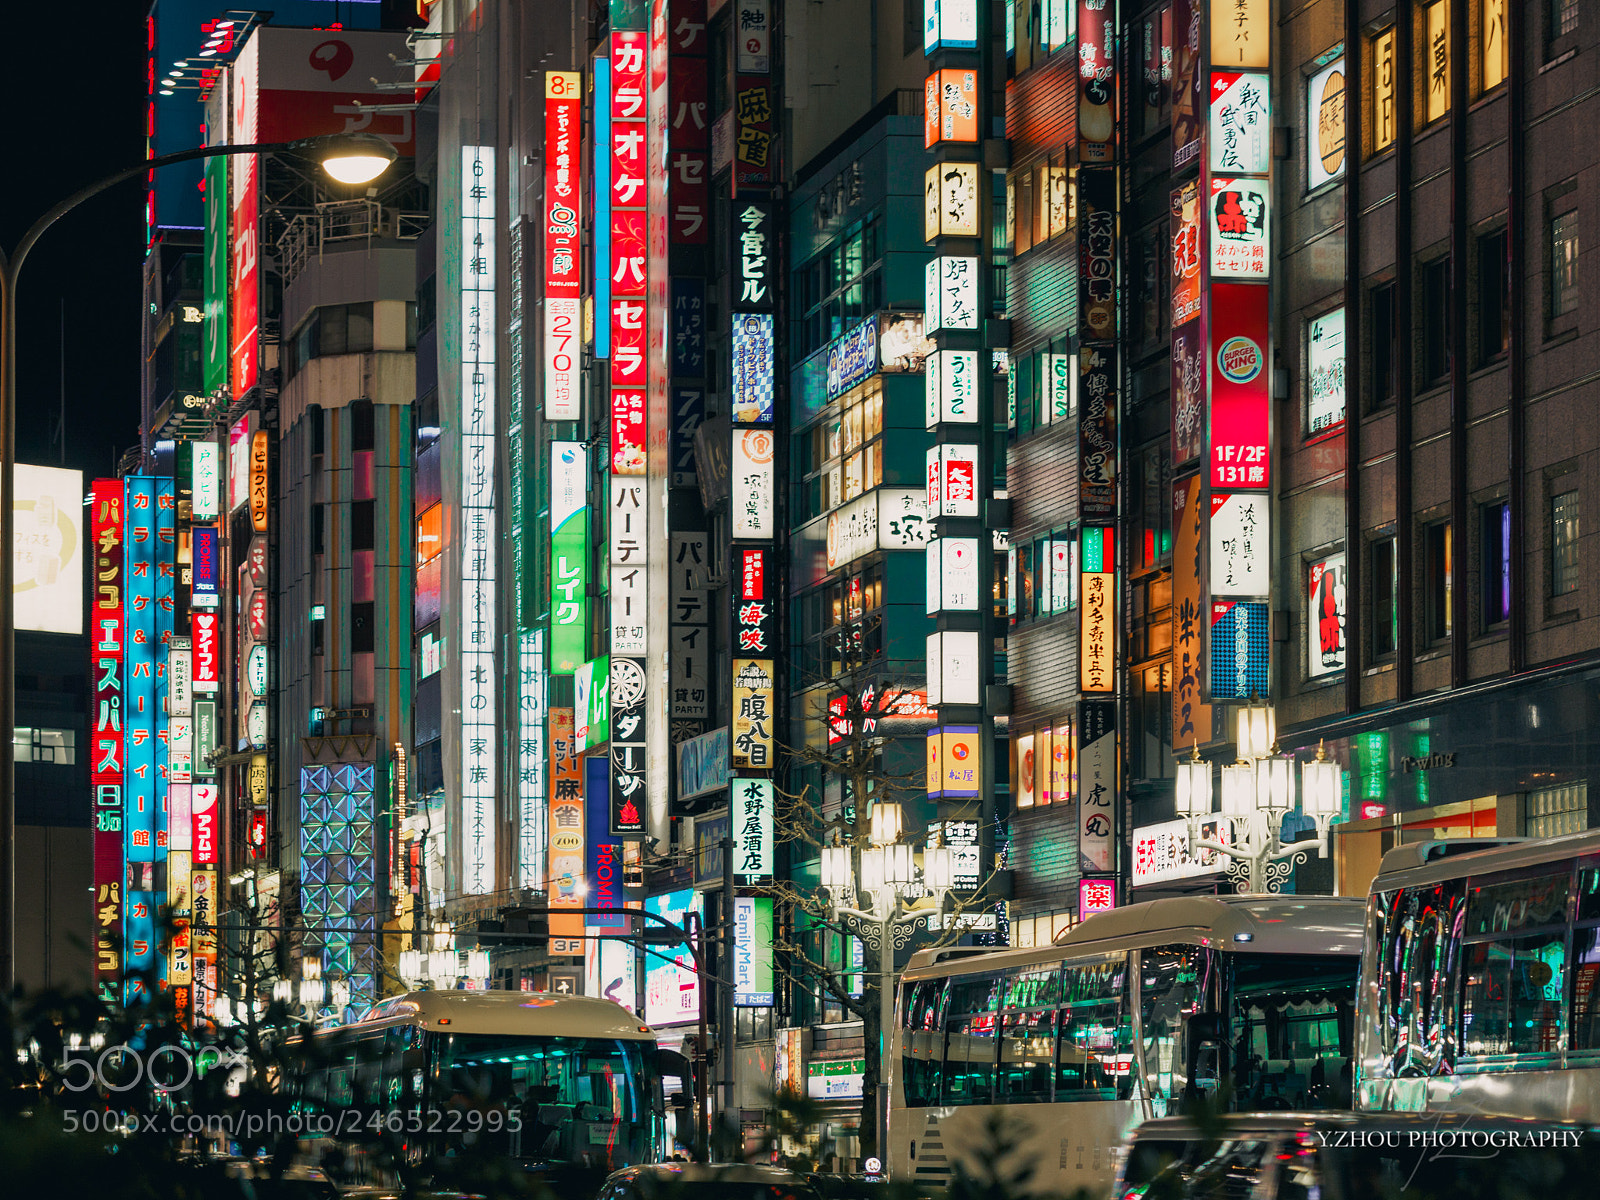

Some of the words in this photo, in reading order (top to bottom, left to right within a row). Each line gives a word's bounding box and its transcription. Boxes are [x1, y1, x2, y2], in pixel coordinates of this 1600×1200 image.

[551, 75, 574, 95] 8F
[615, 43, 645, 204] カラオケ
[738, 87, 771, 169] 麻雀
[1219, 104, 1246, 170] 武勇伝
[672, 101, 706, 237] パセラ
[739, 206, 767, 304] 今宮ビル
[1215, 244, 1264, 259] 赤から鍋
[1215, 259, 1264, 273] セセリ焼
[613, 256, 645, 376] パセラ
[691, 296, 701, 366] カラオケ
[747, 337, 757, 403] ドイツビアホール
[1089, 351, 1107, 368] 4F
[1223, 345, 1255, 362] BURGER
[1225, 352, 1257, 372] KING
[629, 394, 642, 425] 名物
[677, 391, 701, 468] 747
[1216, 446, 1265, 463] 1F/2F
[1217, 466, 1265, 482] 131席
[199, 449, 213, 508] 戸谷ビル
[948, 467, 973, 501] 大陸
[98, 498, 121, 609] パチンコ
[200, 533, 211, 580] PROMISE
[616, 487, 642, 616] パーティー
[1238, 503, 1258, 573] 淡路島と
[557, 556, 580, 624] レイク
[675, 541, 703, 679] パーティー
[952, 594, 964, 605] 3F
[615, 625, 643, 639] 貸切
[615, 642, 643, 650] PARTY
[133, 493, 150, 847] カラオケ&パーティー館
[198, 629, 214, 680] アイフル
[740, 666, 767, 677] 伝説の
[674, 688, 704, 703] 貸切
[674, 706, 705, 714] PARTY
[735, 692, 771, 766] 腹八分目
[554, 739, 567, 775] セット
[616, 715, 641, 797] ダーツ
[735, 757, 749, 766] 2F
[948, 769, 973, 782] 松屋
[1400, 751, 1454, 774] T-wing
[554, 779, 581, 828] 麻雀
[1084, 783, 1111, 838] 虎丸
[198, 815, 212, 851] アコム
[741, 782, 764, 871] 水野屋酒店
[199, 853, 211, 861] 3F
[597, 844, 613, 919] PROMISE
[1085, 884, 1112, 910] 薬
[554, 940, 580, 952] 3F
[735, 905, 752, 986] FamilyMart
[748, 995, 772, 1004] たばこ
